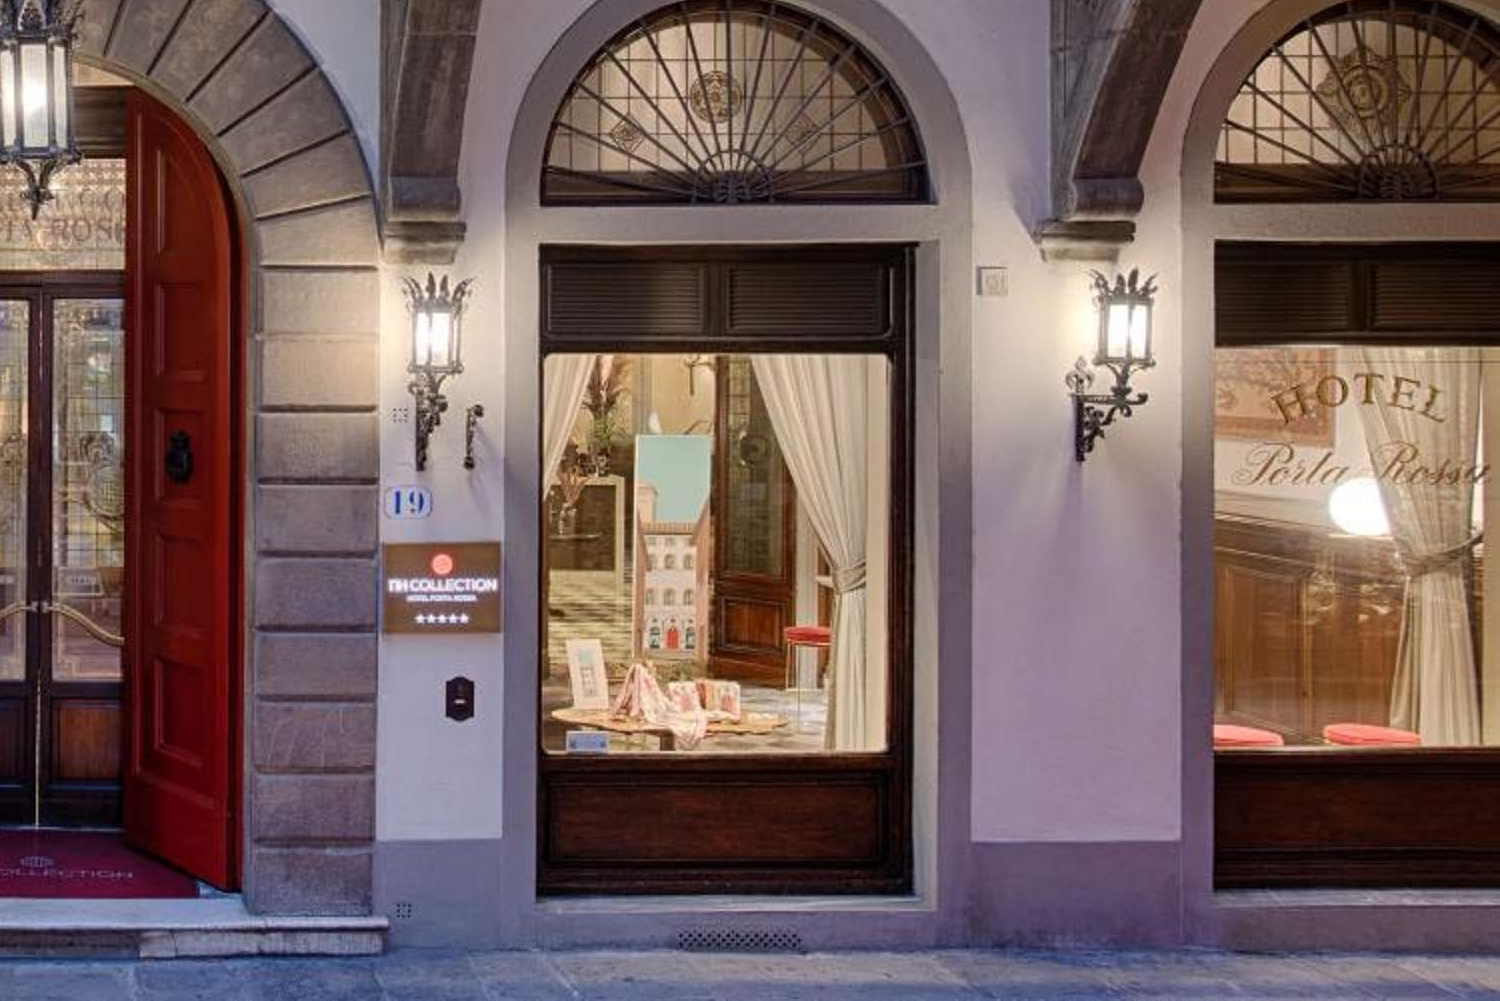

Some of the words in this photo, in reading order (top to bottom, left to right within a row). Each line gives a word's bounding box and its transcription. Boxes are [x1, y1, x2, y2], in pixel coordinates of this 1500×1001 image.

[1271, 373, 1445, 425] HOTEL
[1233, 440, 1349, 487] Porta
[1378, 440, 1491, 487] Rossa
[394, 490, 425, 515] 19
[388, 578, 408, 592] NH
[409, 578, 498, 592] COLLECTION
